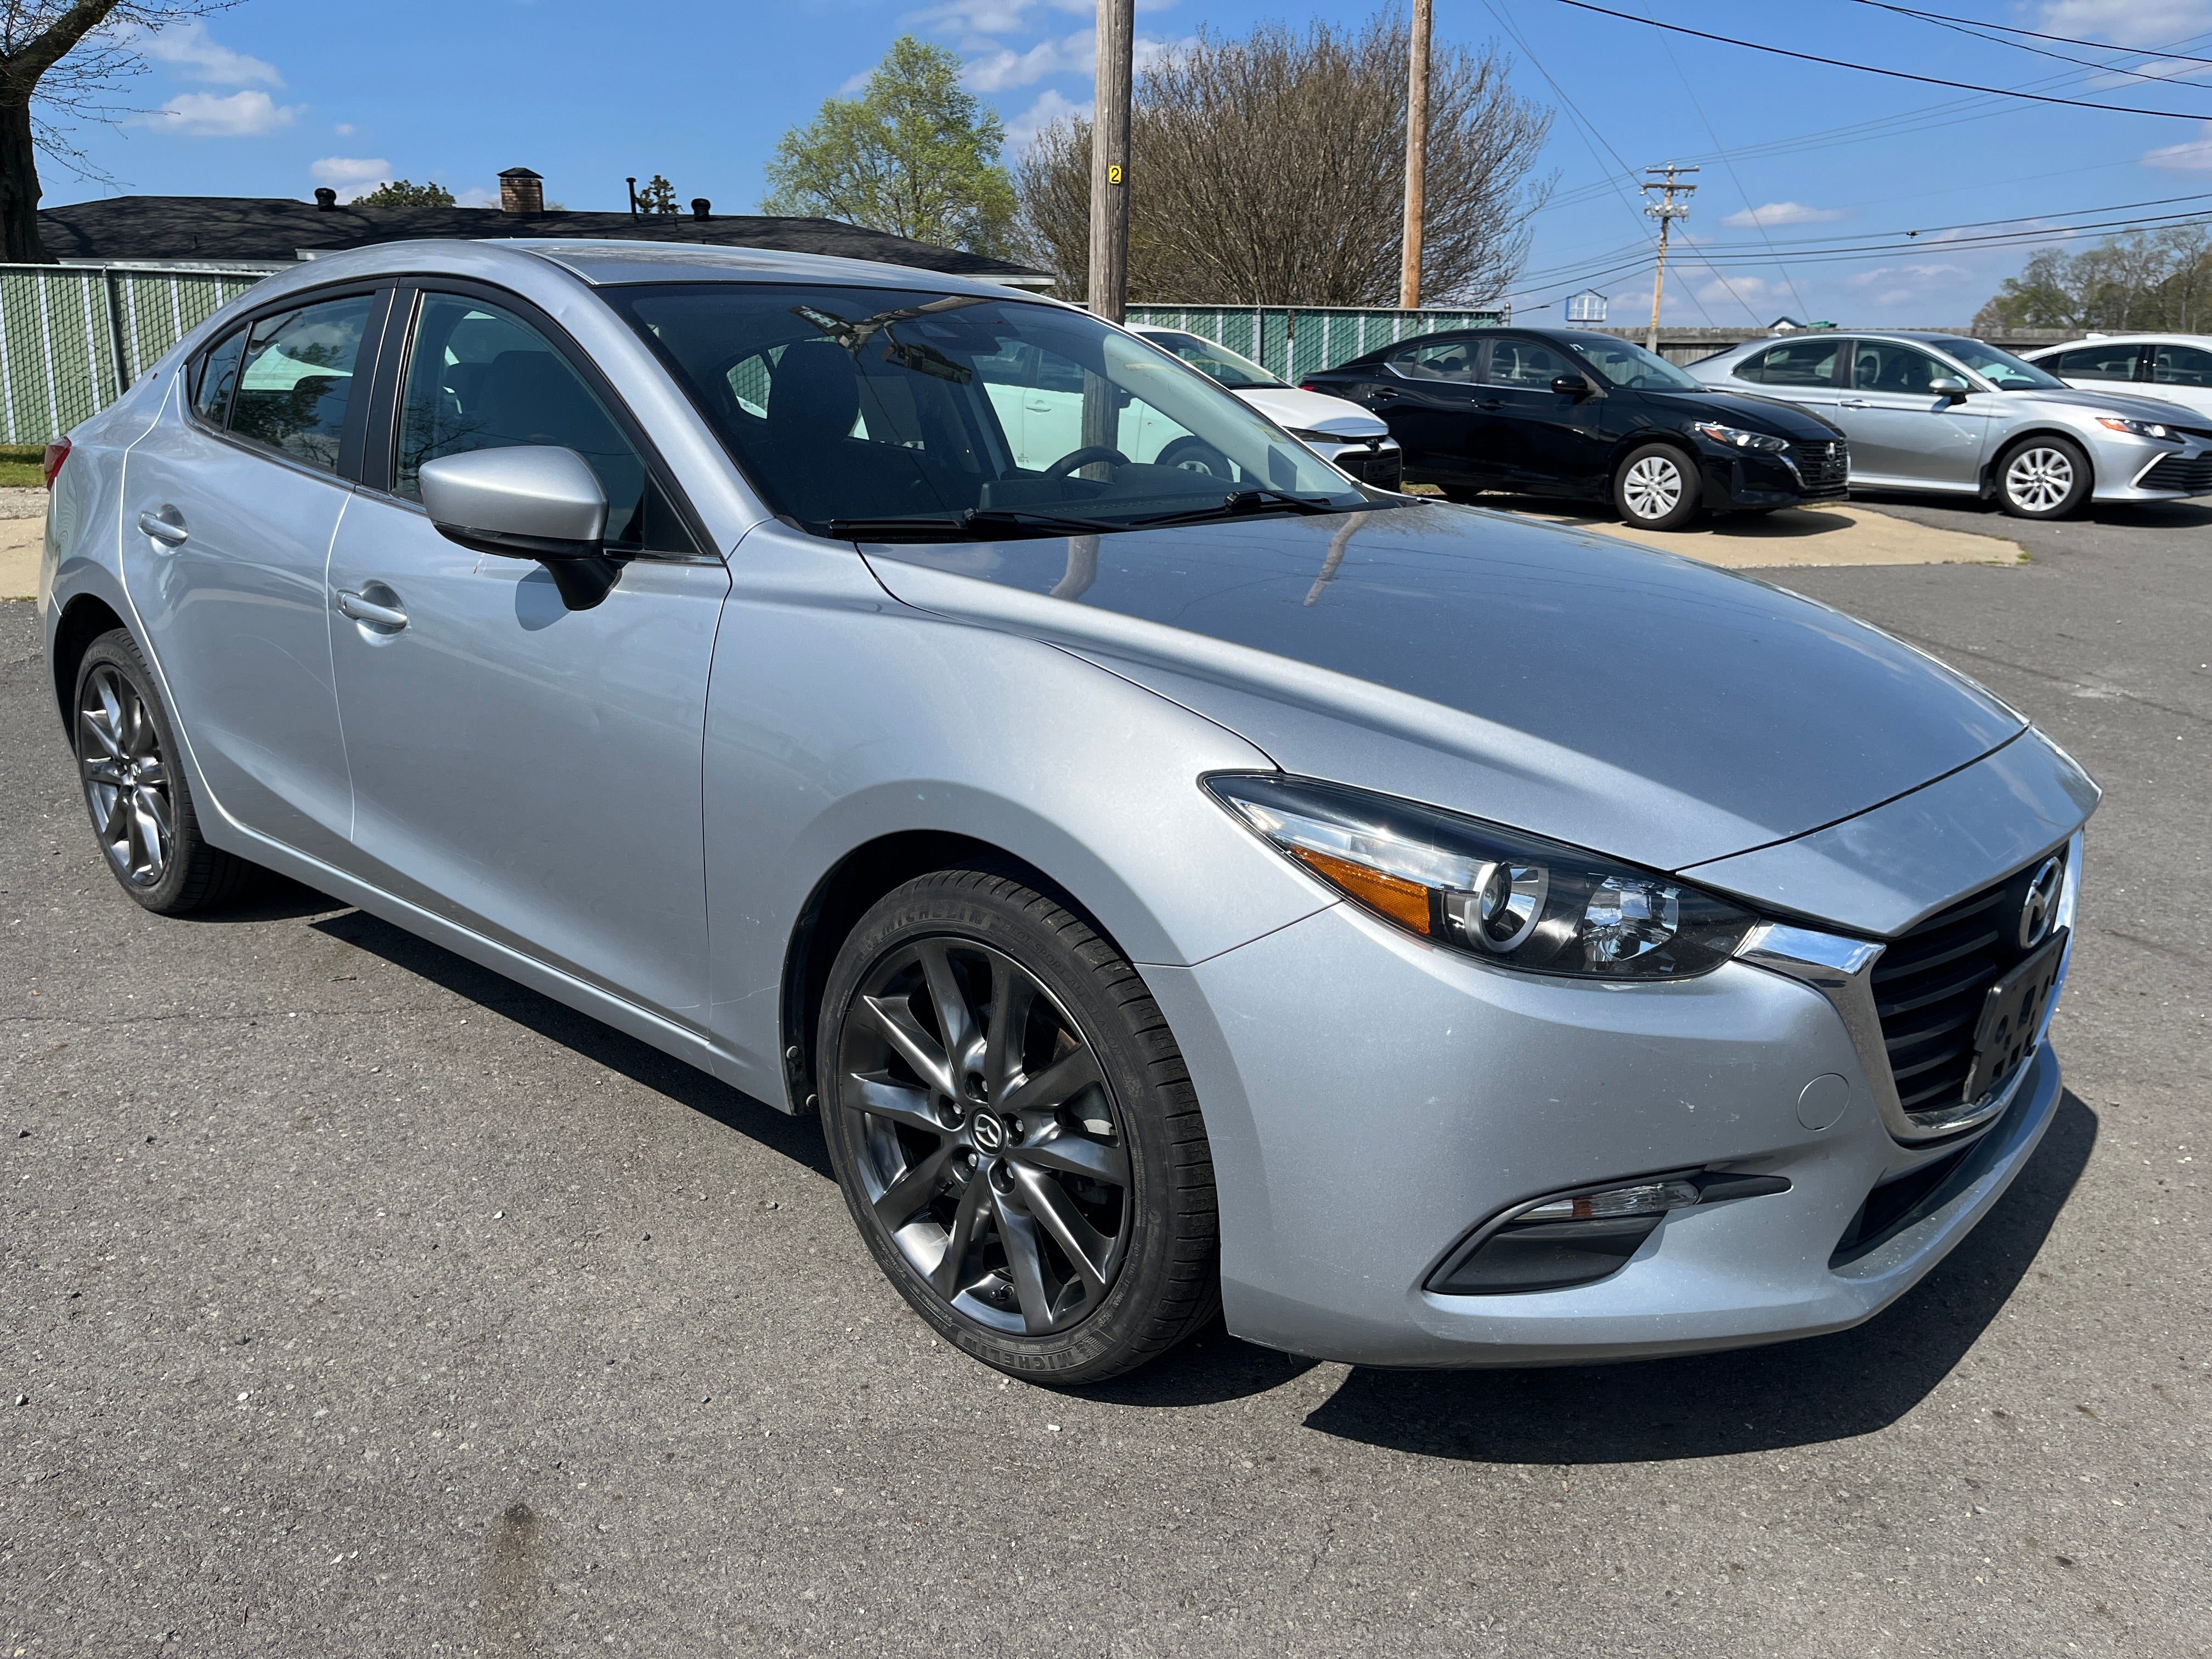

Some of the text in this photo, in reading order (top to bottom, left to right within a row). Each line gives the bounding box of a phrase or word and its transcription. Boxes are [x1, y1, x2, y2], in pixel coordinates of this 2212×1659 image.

[1111, 167, 1120, 182] 2
[881, 903, 986, 939] MICHELIN
[1002, 919, 1032, 947] PILOT
[1033, 939, 1069, 979] SPORT
[1066, 972, 1090, 1003] ALL
[962, 1334, 1075, 1371] MICHELIN
